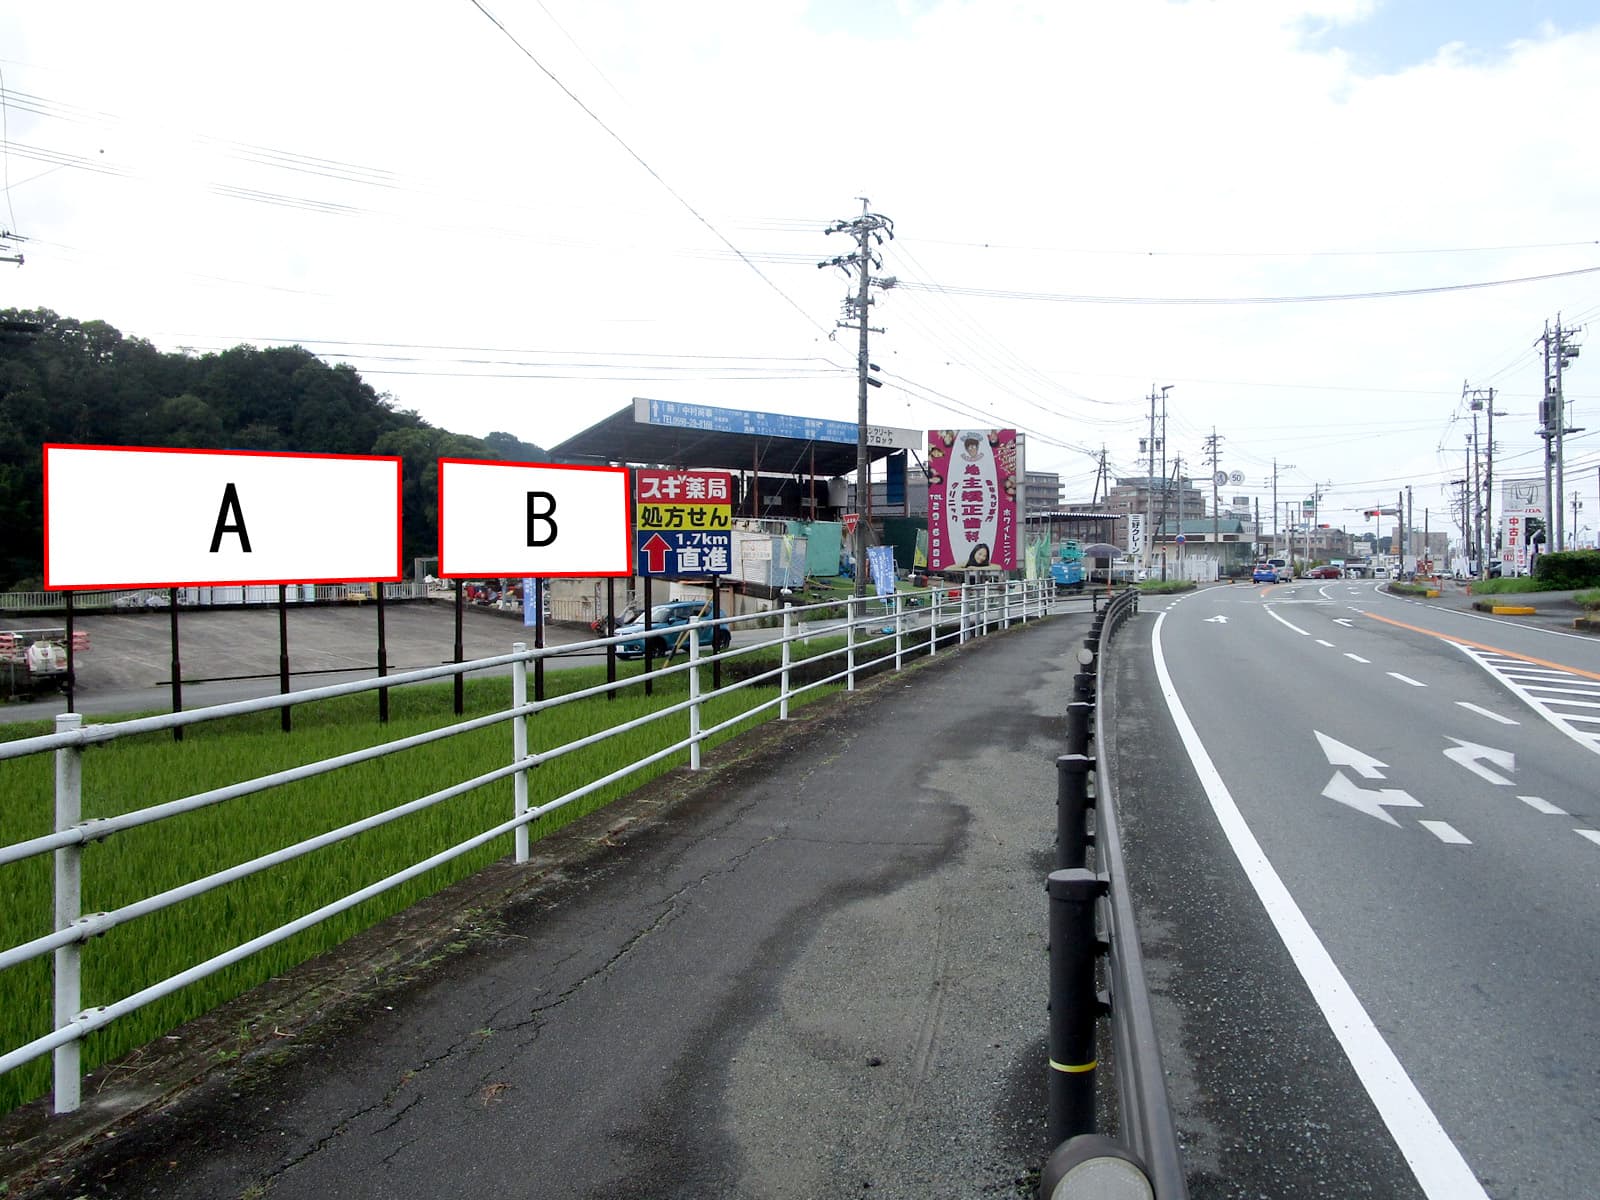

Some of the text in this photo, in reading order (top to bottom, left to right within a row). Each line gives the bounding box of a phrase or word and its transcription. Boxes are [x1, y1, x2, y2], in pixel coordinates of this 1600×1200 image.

[641, 475, 727, 498] スギ薬局
[641, 506, 728, 528] 処方せん
[676, 533, 728, 545] 1.7km
[1002, 508, 1012, 566] ホワイトニング
[676, 546, 728, 572] 直進
